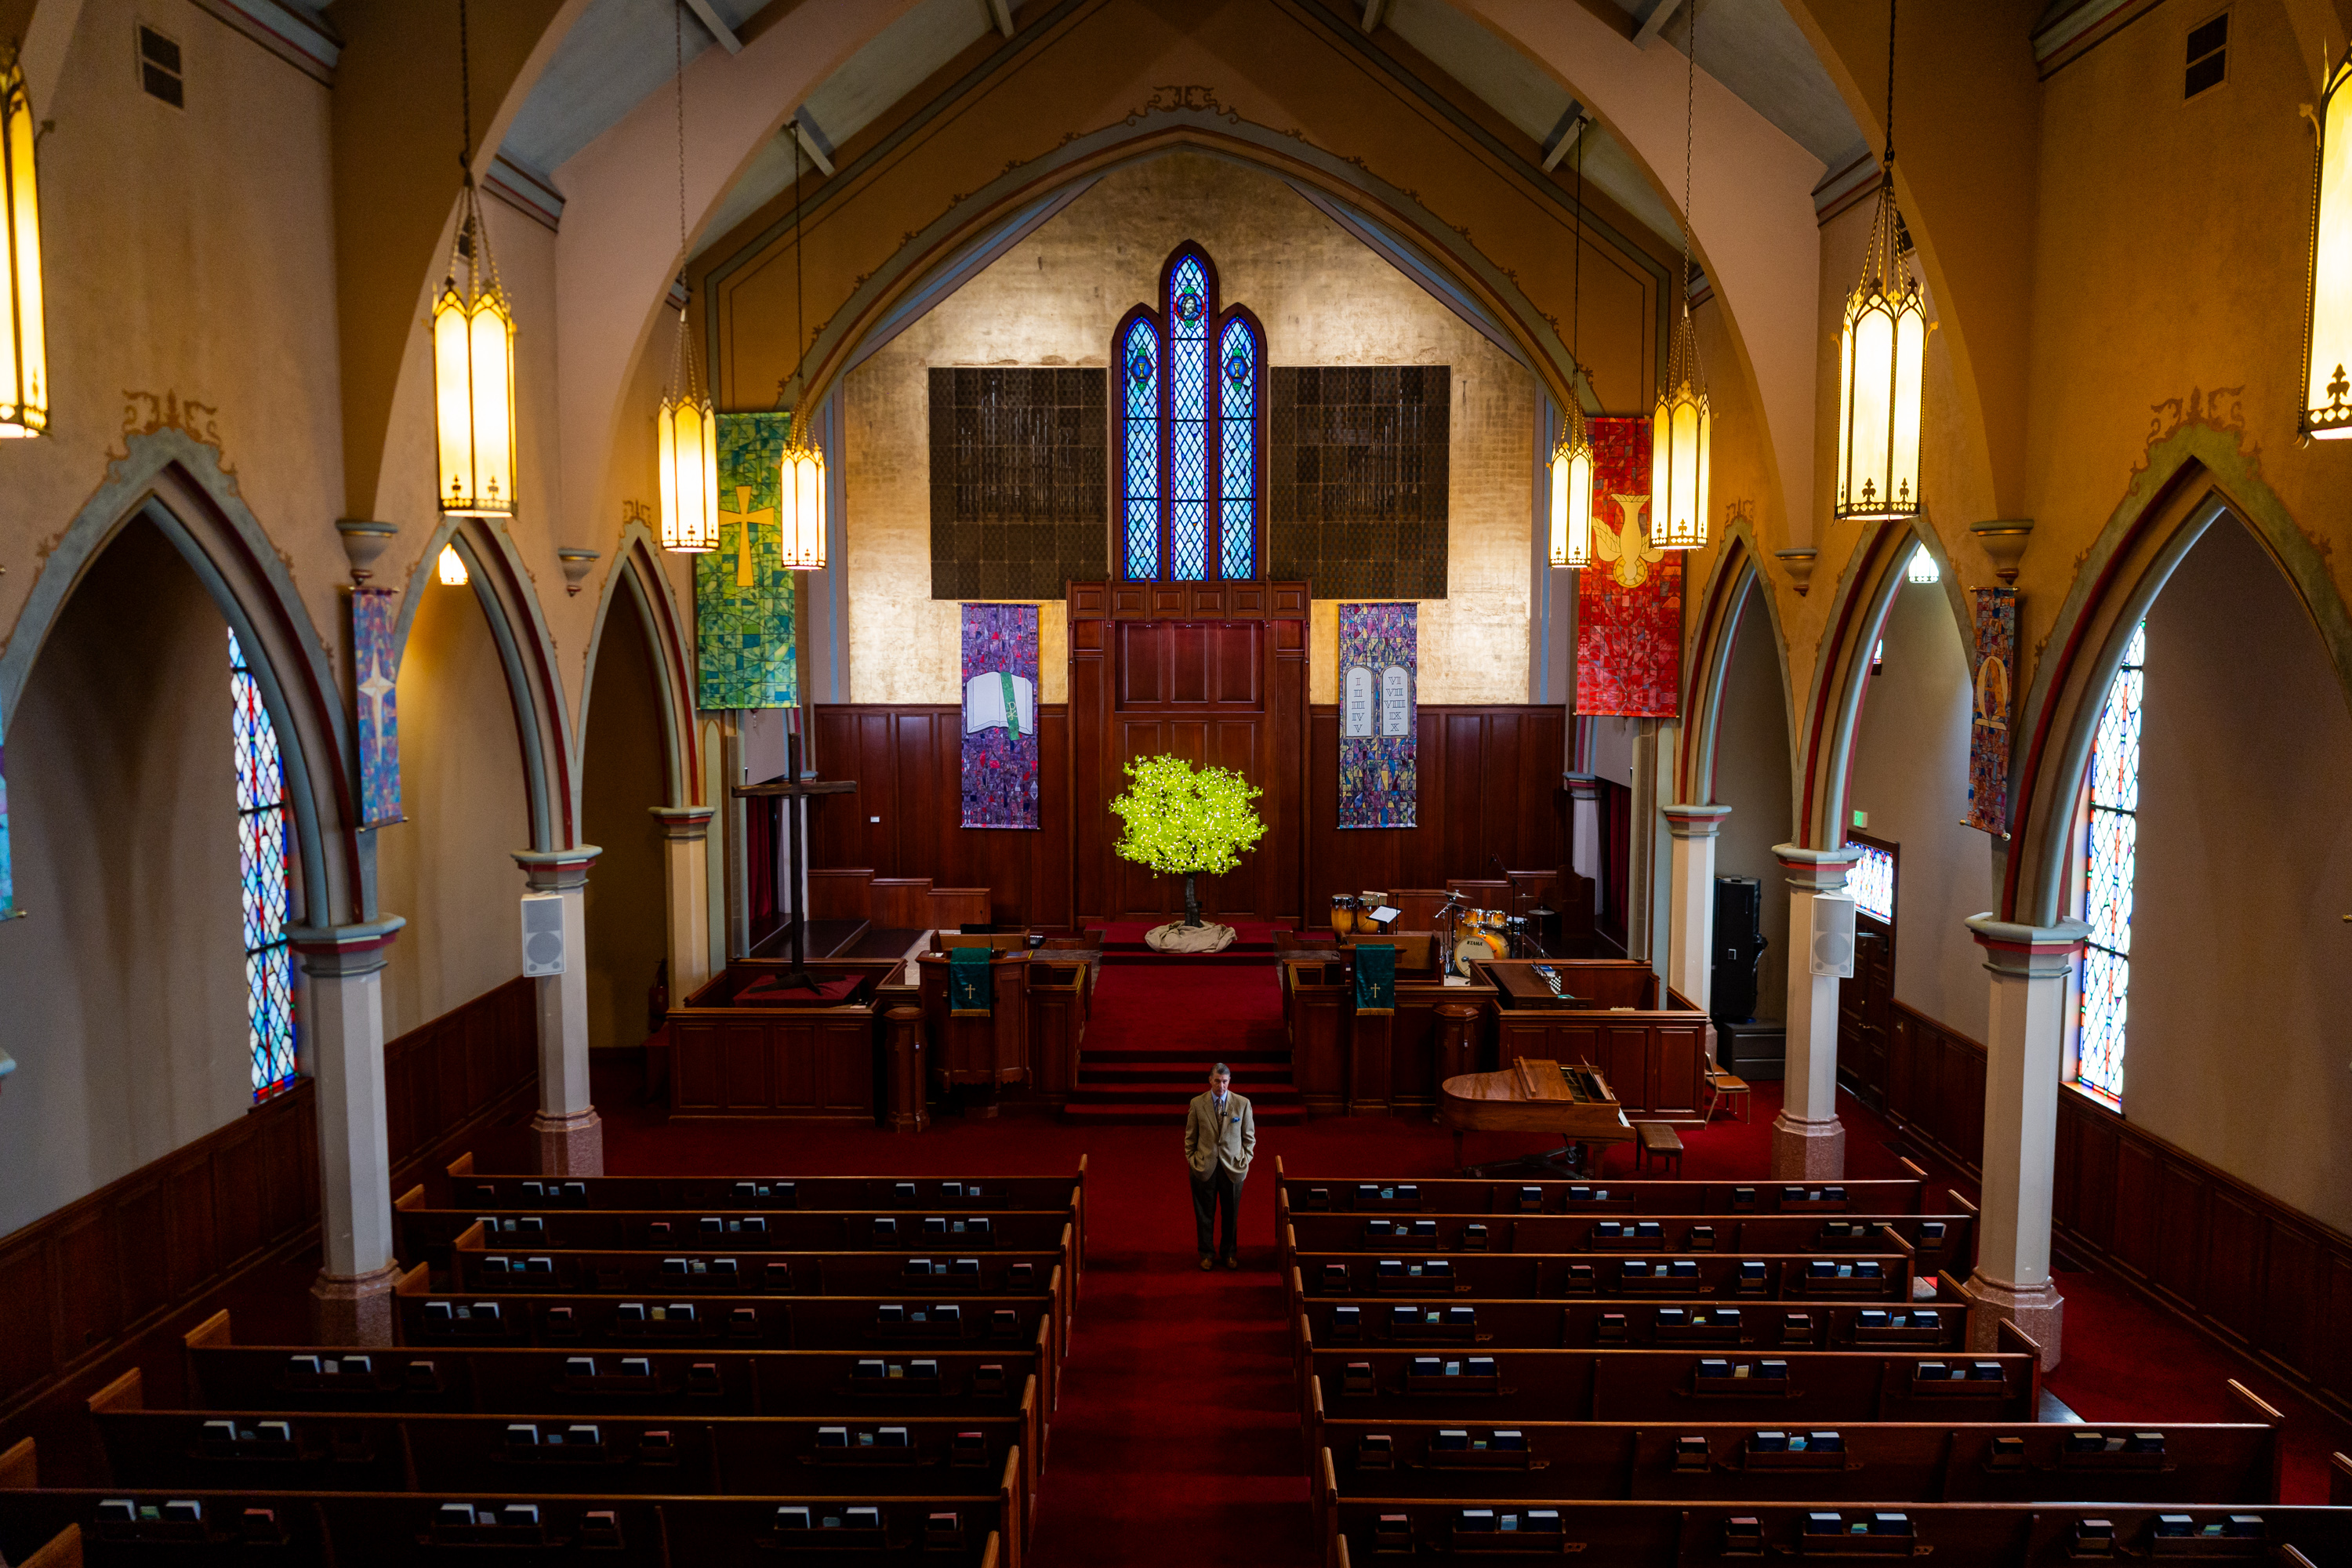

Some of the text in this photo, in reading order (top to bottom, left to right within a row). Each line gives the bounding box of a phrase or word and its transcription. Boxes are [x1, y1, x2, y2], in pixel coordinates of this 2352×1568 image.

[1355, 677, 1361, 686] I
[1388, 676, 1401, 684] VI
[1354, 688, 1363, 698] II
[1386, 688, 1403, 697] VII
[1352, 700, 1365, 710] III
[1384, 699, 1406, 709] VIII
[1352, 712, 1364, 721] IV
[1389, 711, 1402, 720] IX
[1353, 724, 1363, 732] V
[1390, 723, 1399, 731] X
